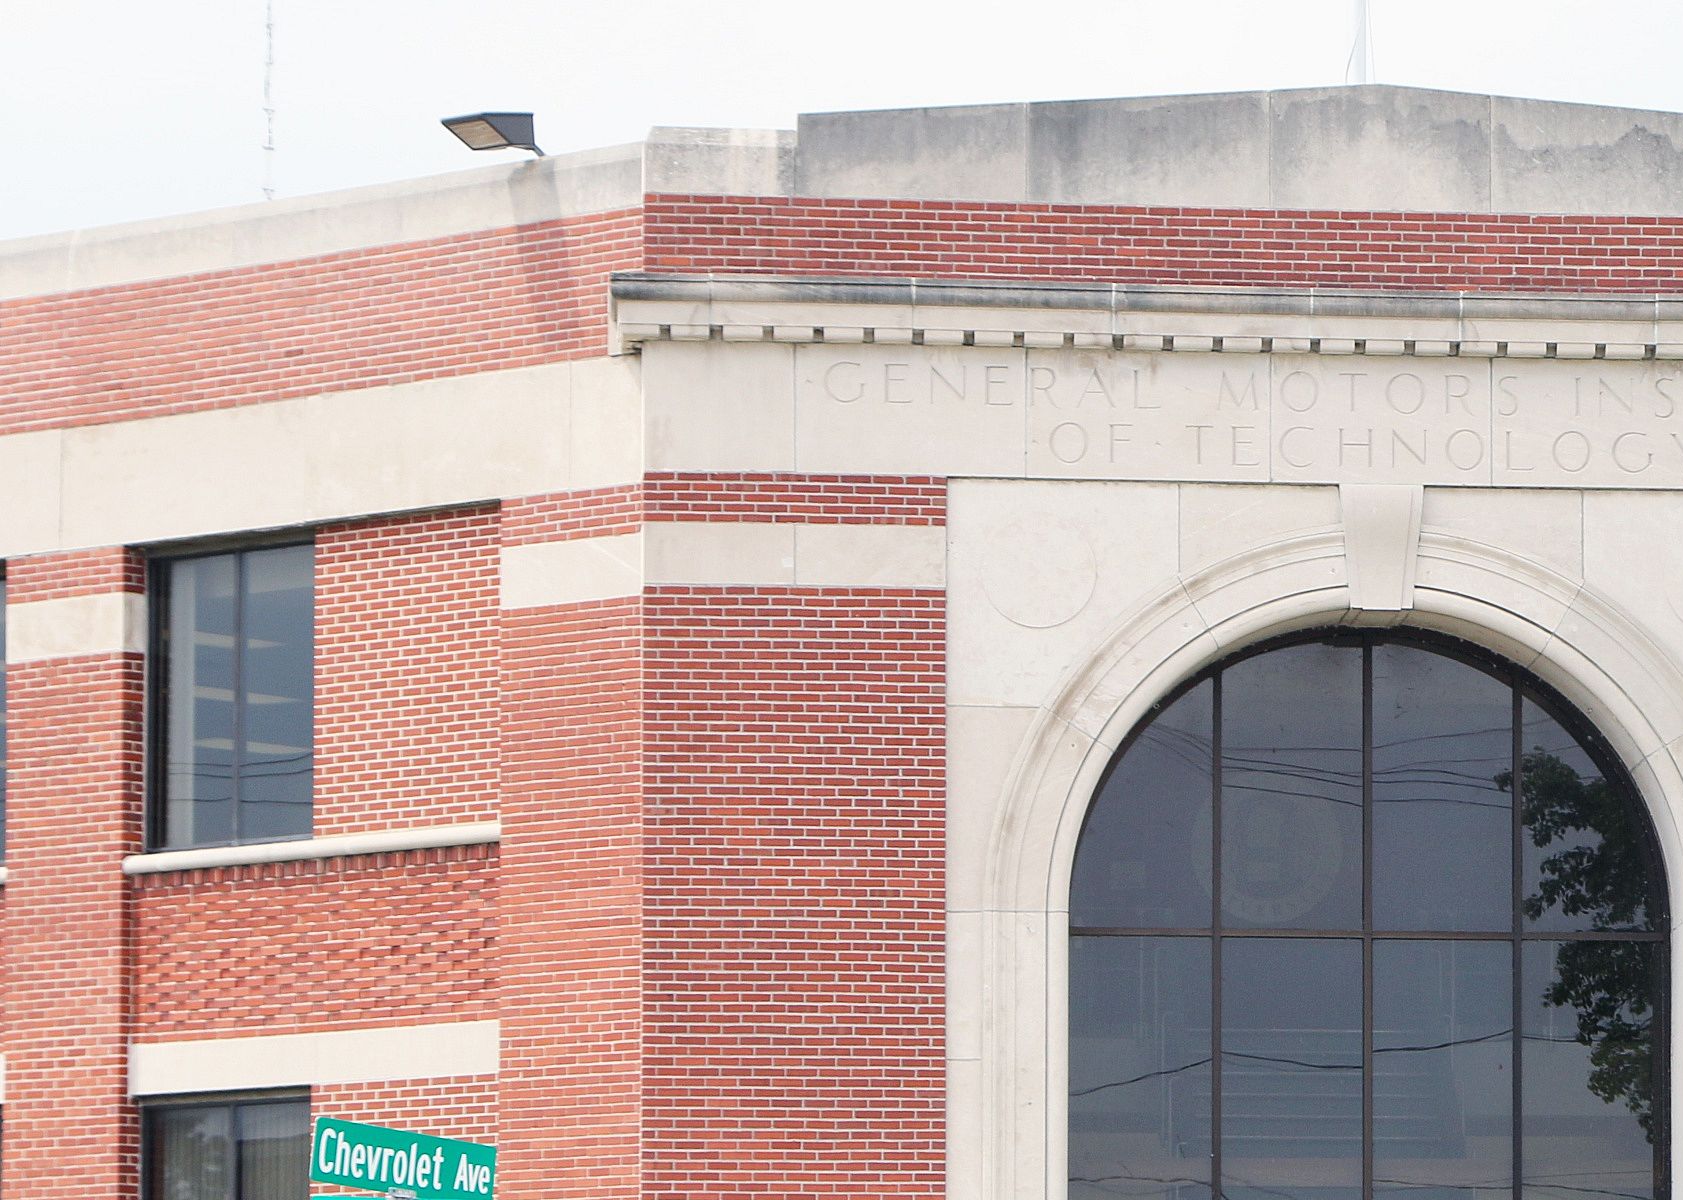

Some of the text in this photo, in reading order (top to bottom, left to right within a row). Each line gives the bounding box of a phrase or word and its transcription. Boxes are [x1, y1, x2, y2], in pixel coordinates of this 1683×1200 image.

[822, 360, 1163, 410] GENERAL
[1216, 369, 1521, 418] MOTORS
[1048, 421, 1134, 465] OF
[318, 1127, 491, 1194] Chevrolet Ave
